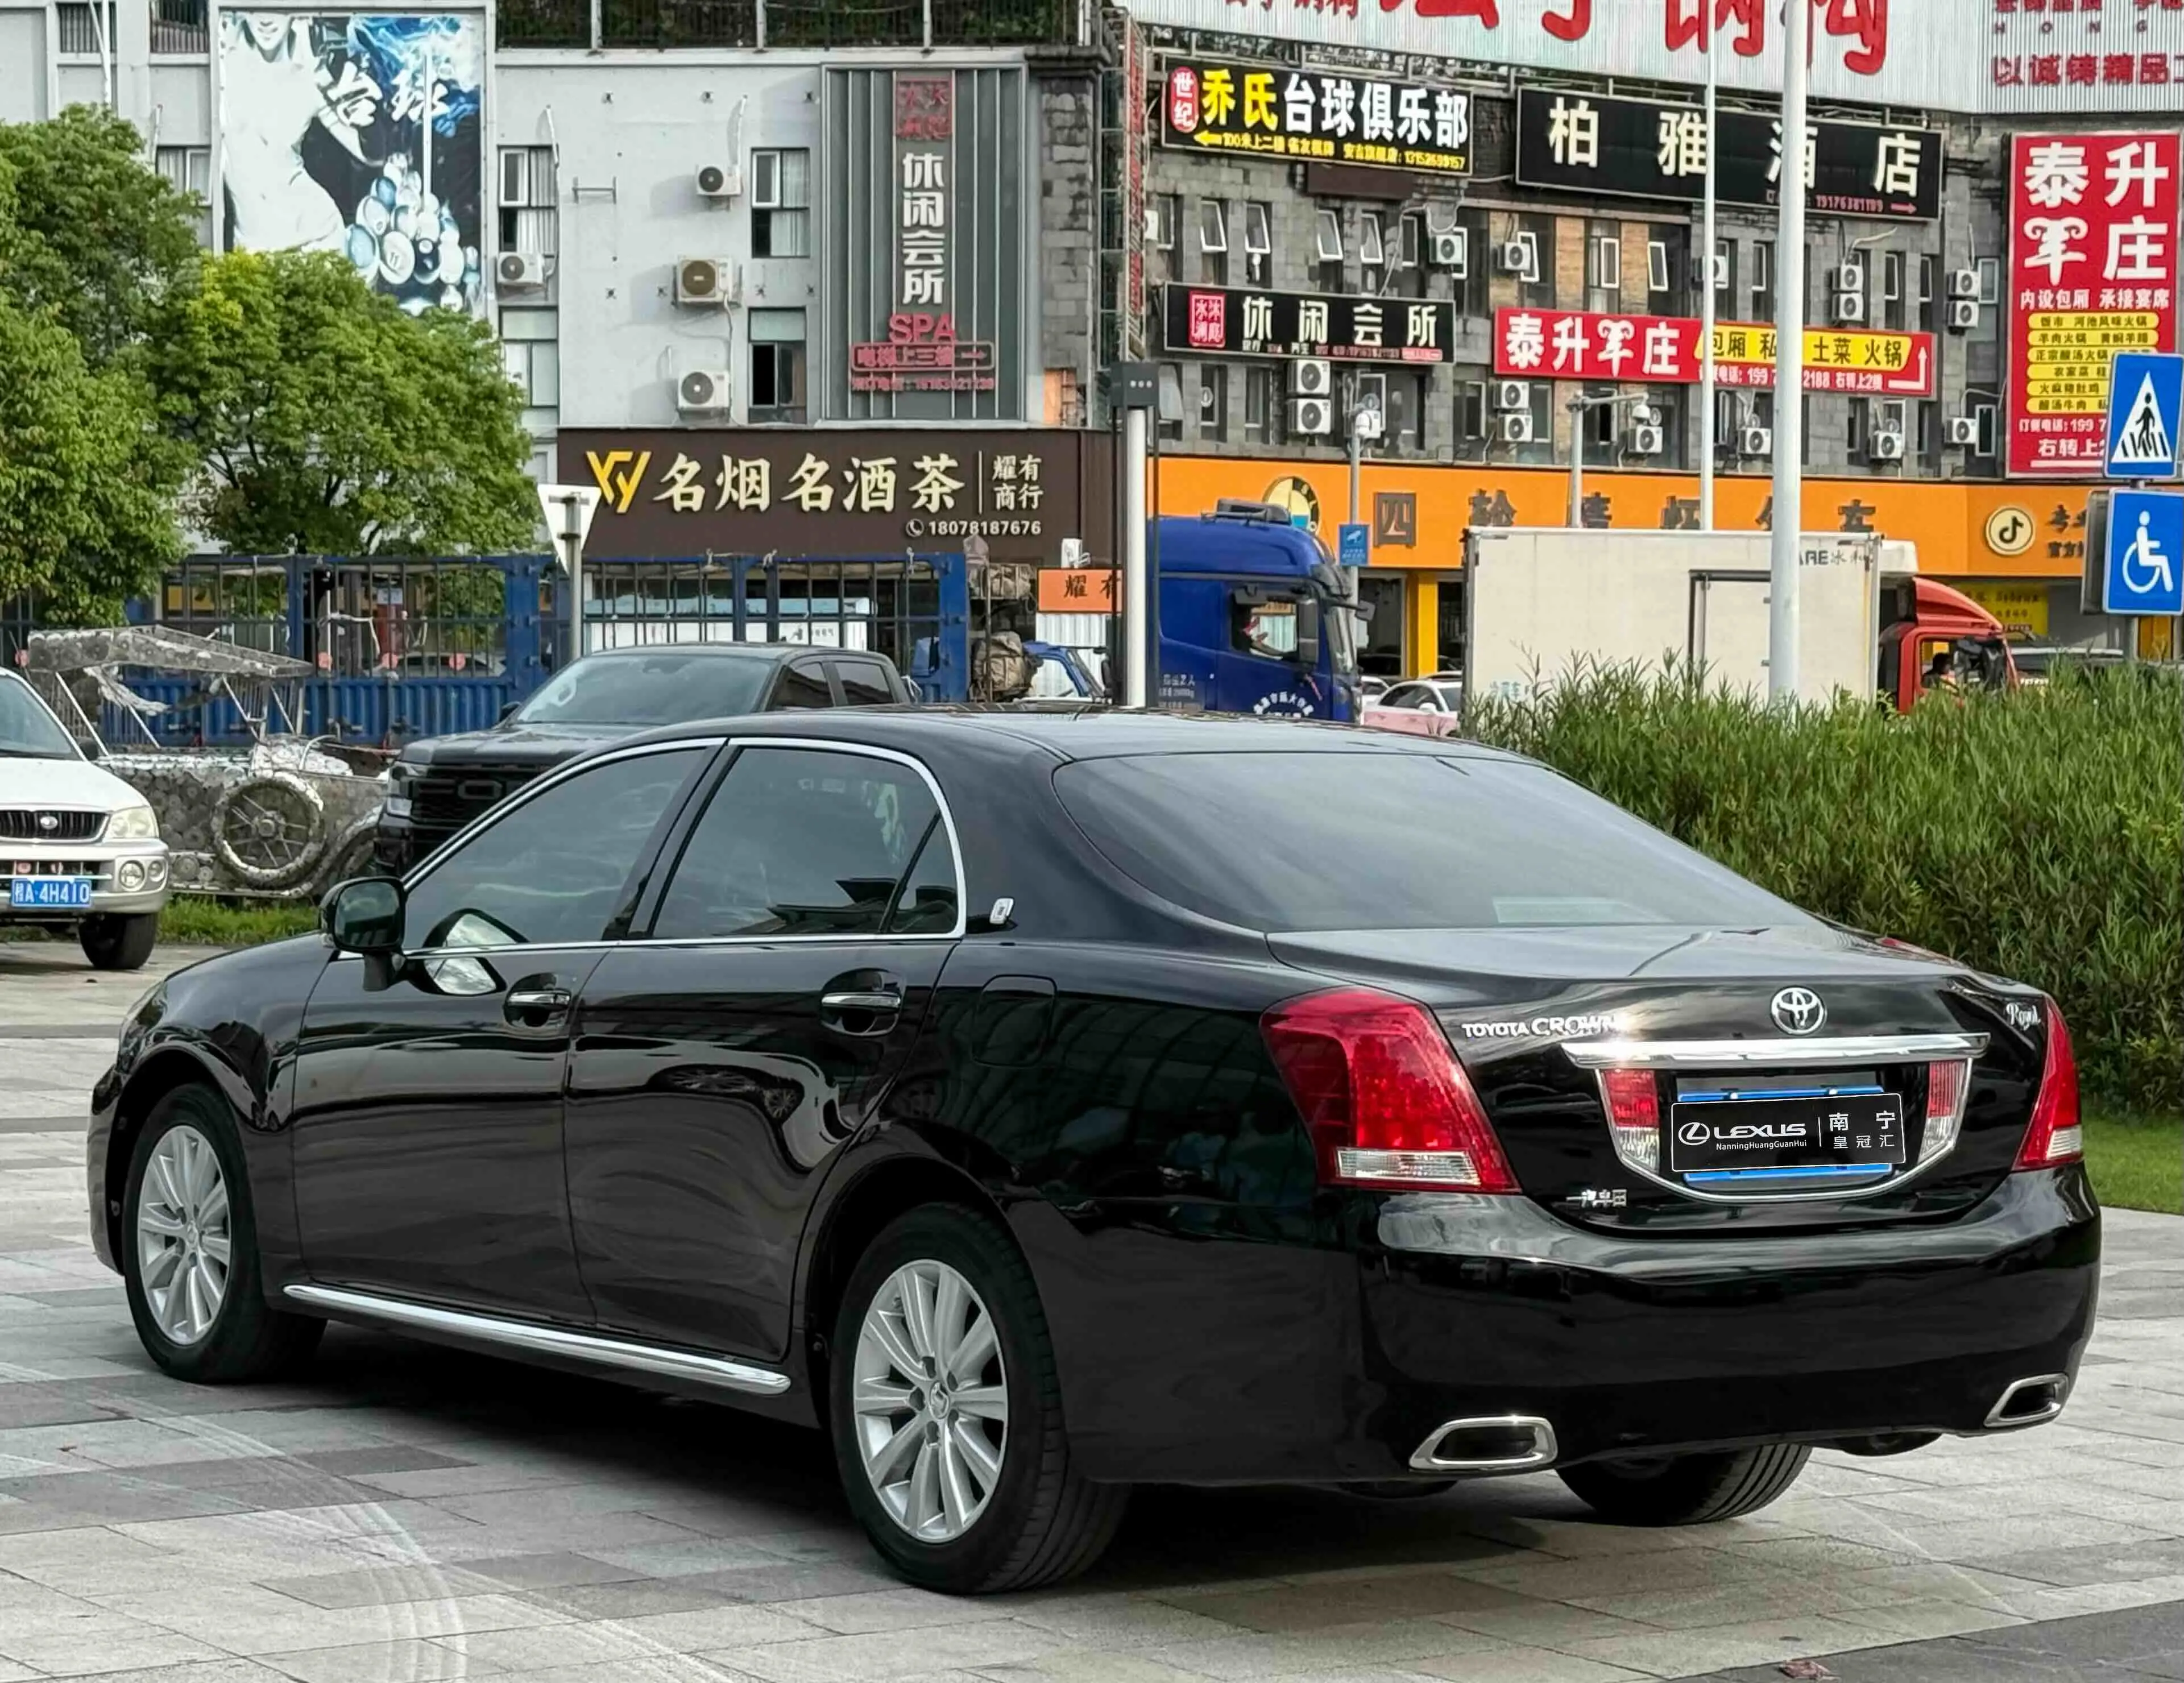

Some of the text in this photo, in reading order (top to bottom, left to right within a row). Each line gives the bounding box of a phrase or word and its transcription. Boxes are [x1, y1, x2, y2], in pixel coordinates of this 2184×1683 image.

[327, 61, 450, 127] 台球
[1173, 72, 1197, 126] 世纪
[1201, 68, 1469, 148] 乔氏台球俱乐部
[2024, 141, 2169, 208] 泰升
[902, 152, 945, 304] 休闲会所
[890, 313, 956, 342] SPA
[1242, 296, 1437, 346] 休闲会所
[1812, 337, 1852, 364] 土菜
[1864, 338, 1903, 367] 火锅
[992, 454, 1042, 481] 耀有
[653, 453, 965, 513] 名烟名酒茶
[993, 482, 1044, 510] 商行
[929, 520, 1042, 535] 18078187676
[1462, 1015, 1622, 1038] TOYOTA CROWN
[1714, 1123, 1807, 1139] LEXUS
[1828, 1110, 1896, 1132] 南宁
[1715, 1139, 1808, 1152] NanningHuangGuanHui
[1833, 1134, 1895, 1150] 皇冠汇
